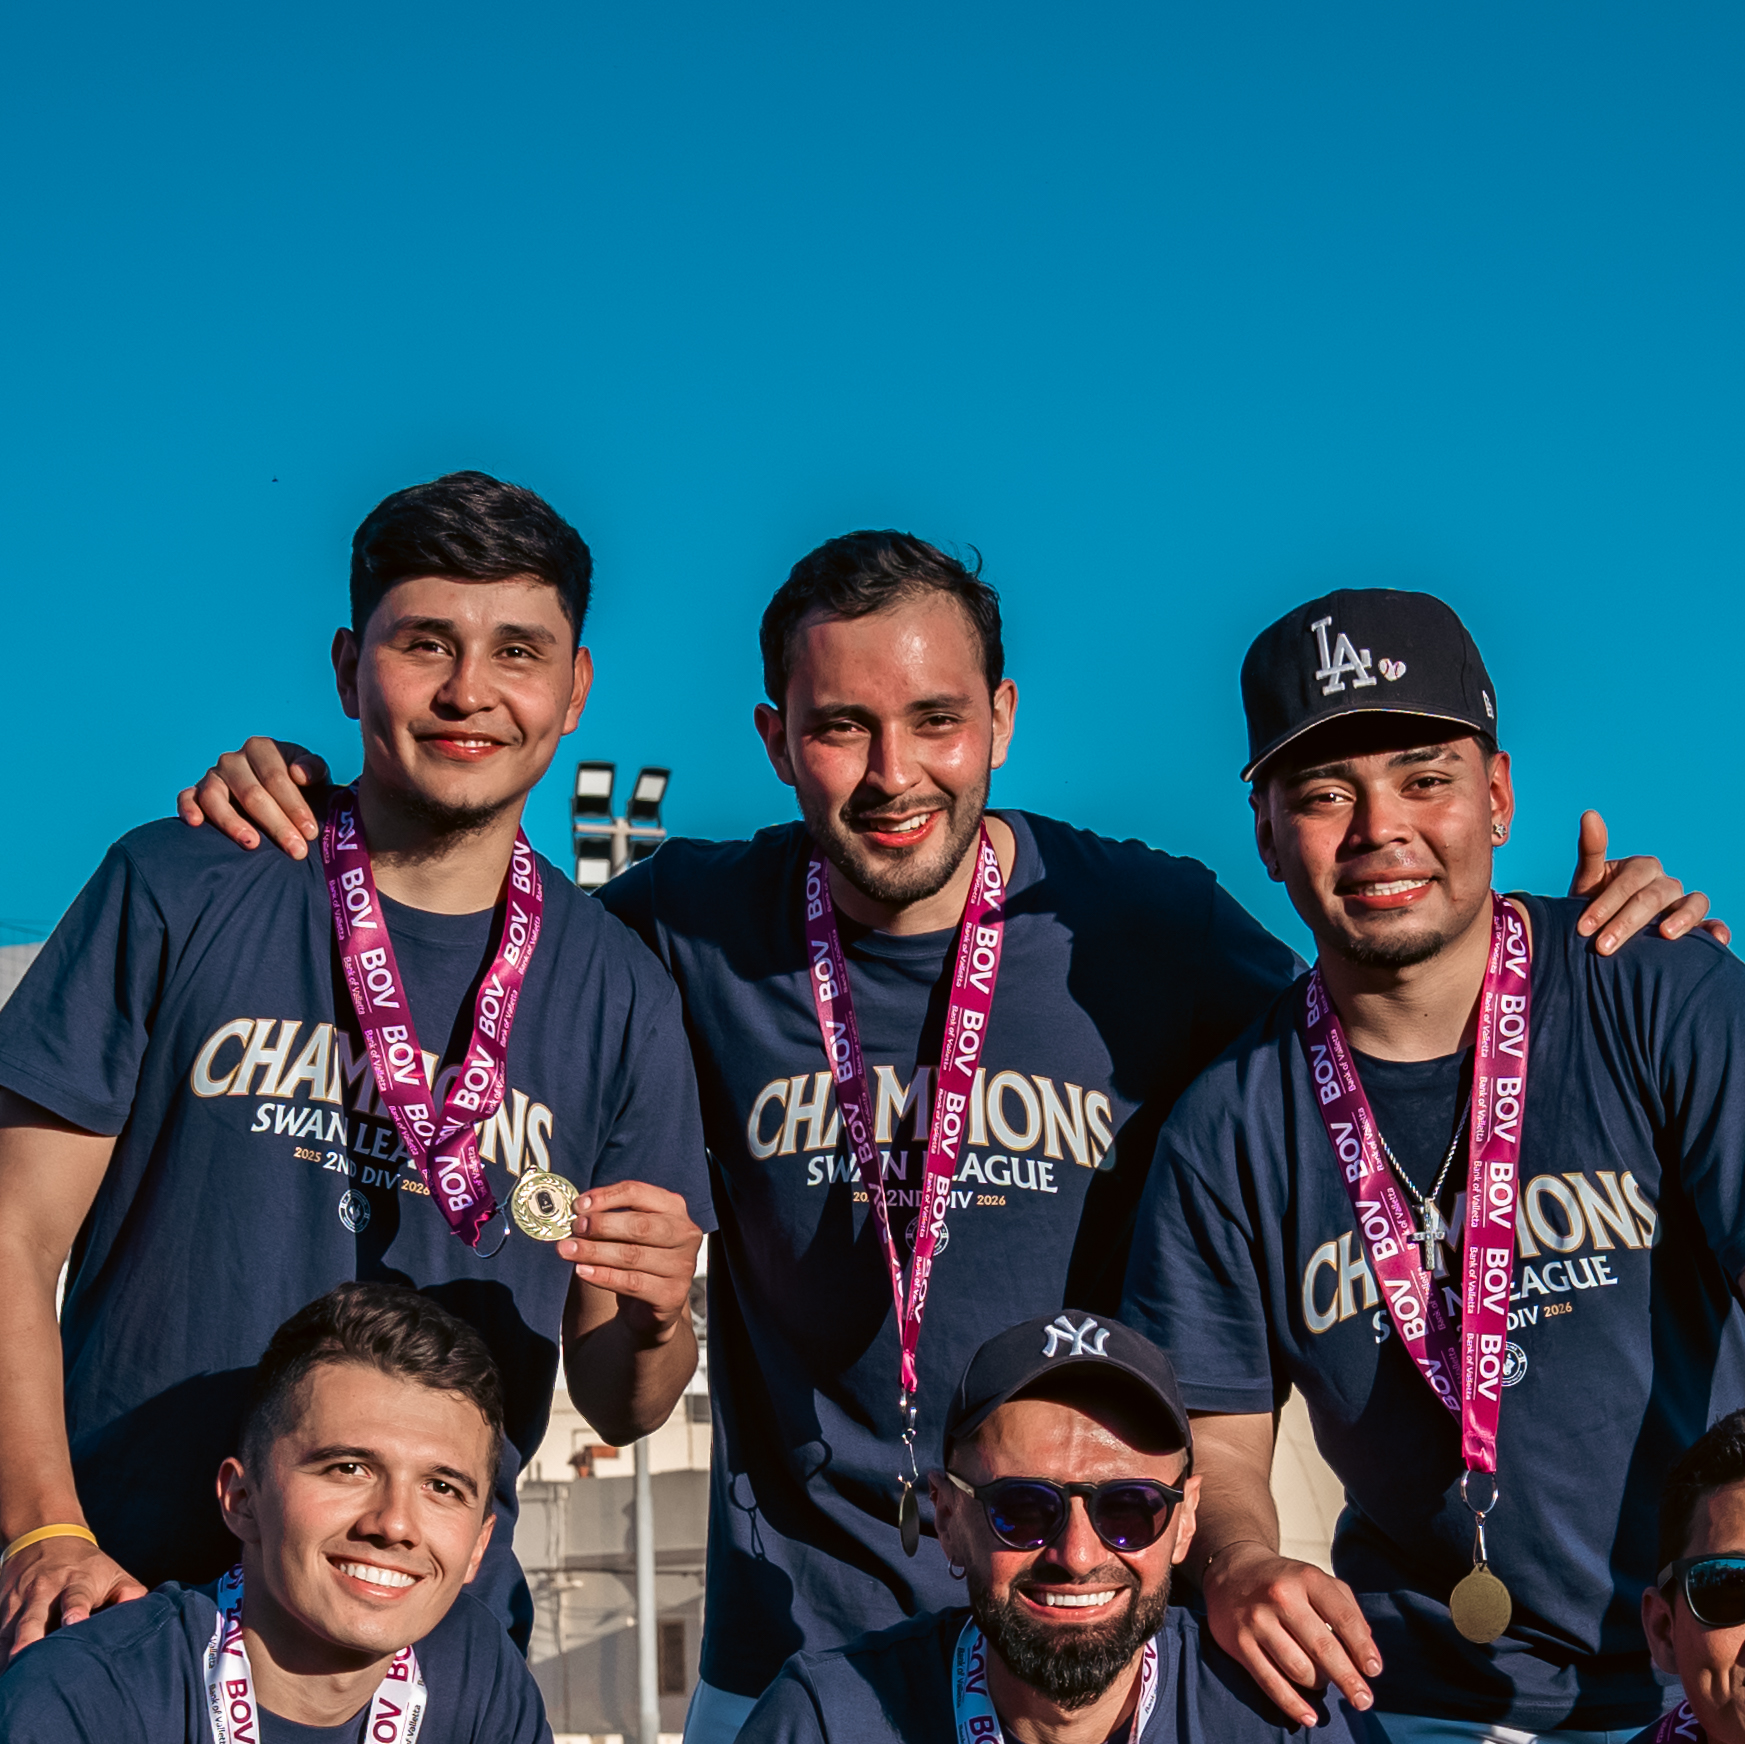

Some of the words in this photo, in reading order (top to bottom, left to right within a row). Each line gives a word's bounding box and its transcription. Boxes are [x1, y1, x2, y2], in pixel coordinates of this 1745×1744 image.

[1311, 616, 1377, 696] LA
[342, 867, 377, 928] BOV
[512, 840, 532, 894] BOV
[807, 860, 824, 921] BOV
[983, 846, 1001, 911] BOV
[503, 901, 529, 966] BOV
[969, 926, 998, 995] BOV
[361, 947, 400, 1008] BOV
[811, 940, 839, 1002] BOV
[479, 974, 505, 1039] BOV
[1498, 994, 1526, 1058] BOV
[382, 1025, 420, 1086] BOV
[826, 1020, 853, 1083] BOV
[955, 1009, 984, 1078] BOV
[453, 1044, 494, 1111] BOV
[1311, 1044, 1341, 1105] BOV
[251, 1103, 349, 1146] SWAN
[844, 1102, 873, 1164] BOV
[942, 1091, 966, 1159] BOV
[1494, 1076, 1522, 1144] BOV
[293, 1147, 322, 1163] 2025
[322, 1151, 357, 1178] 2ND
[362, 1166, 400, 1190] DIV
[401, 1179, 431, 1196] 2026
[1331, 1122, 1369, 1183] BOV
[1473, 1161, 1481, 1180] Bank
[434, 1156, 474, 1211] BOV
[930, 1175, 950, 1238] BOV
[977, 1195, 1006, 1206] 2026
[1471, 1194, 1479, 1228] Valletta
[1488, 1162, 1513, 1229] BOV
[1355, 1200, 1399, 1261] BOV
[1384, 1279, 1426, 1341] BOV
[1467, 1280, 1475, 1314] Valletta
[1483, 1248, 1510, 1316] BOV
[1544, 1302, 1573, 1319] 2026
[1042, 1315, 1110, 1358] NY
[1417, 1357, 1460, 1412] BOV
[1465, 1367, 1473, 1400] Valletta
[1478, 1334, 1502, 1401] BOV
